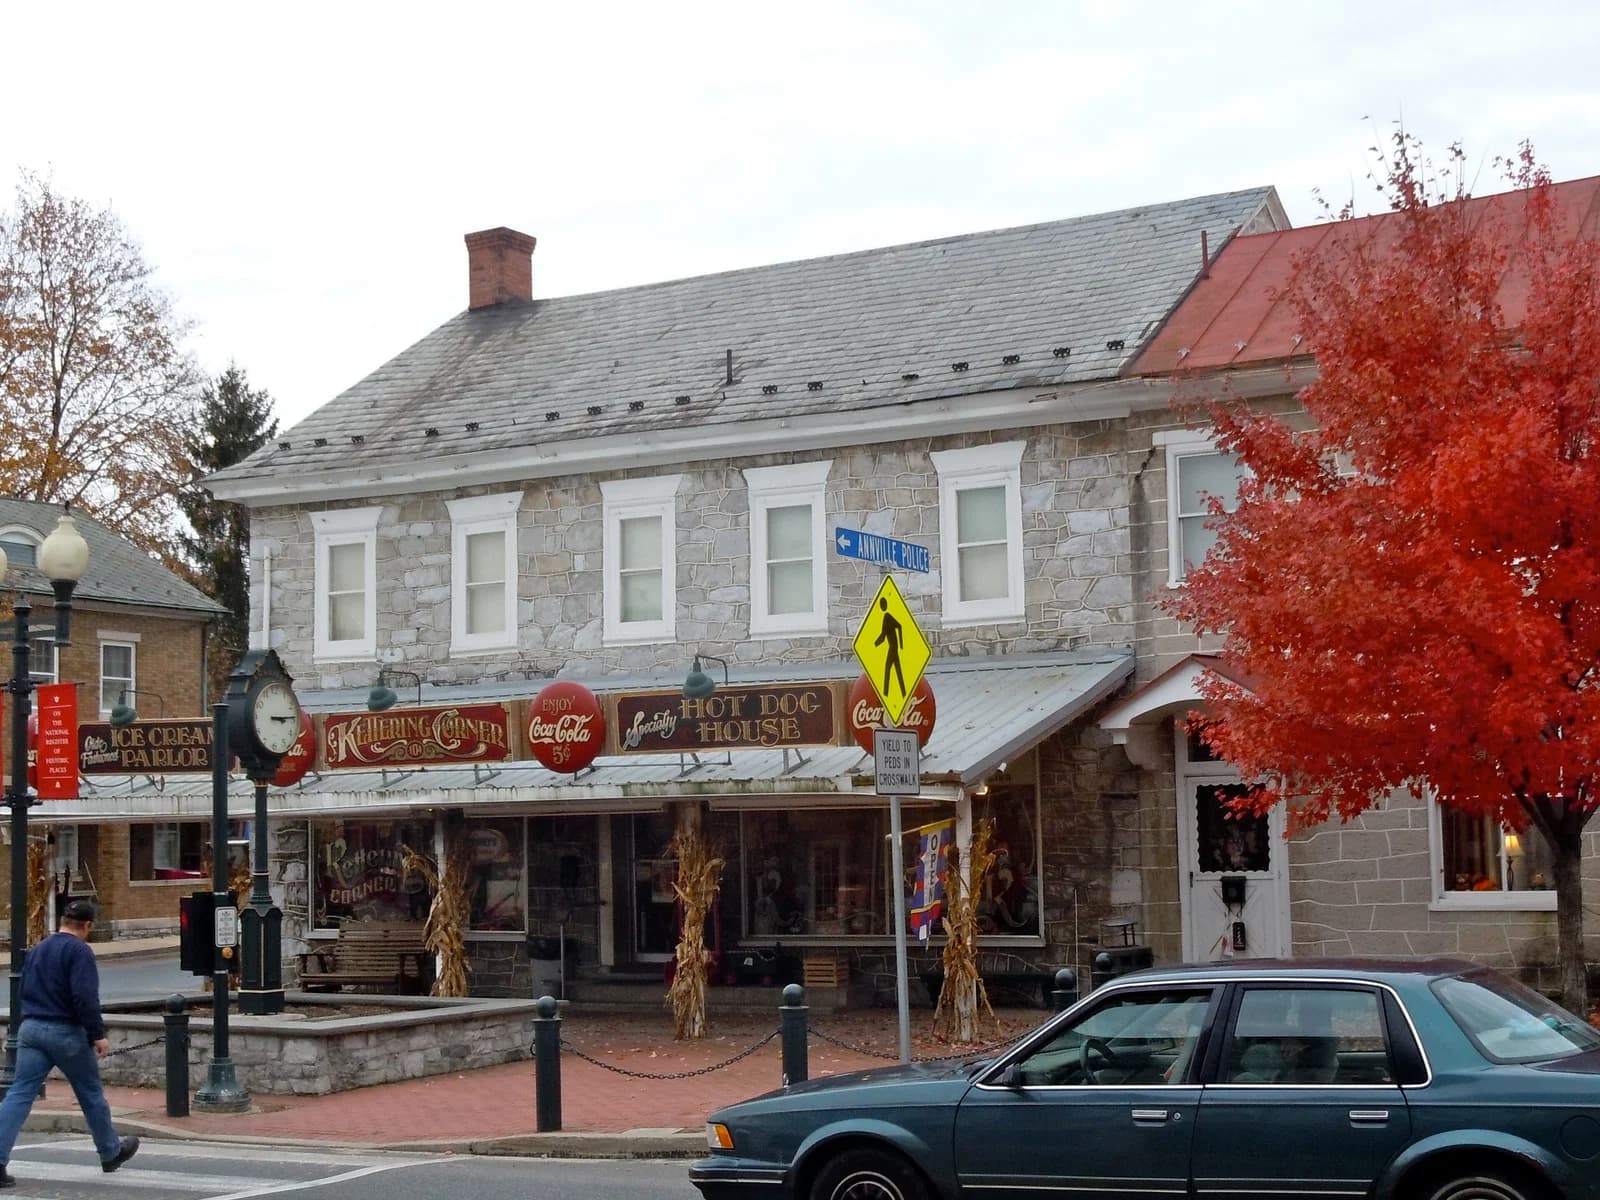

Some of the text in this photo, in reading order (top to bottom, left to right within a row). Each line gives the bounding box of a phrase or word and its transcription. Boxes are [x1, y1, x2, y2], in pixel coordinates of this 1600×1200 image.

[858, 535, 928, 571] ANNVILLE POLICE
[542, 696, 576, 716] ENJOY
[679, 692, 821, 719] HOT DOG
[110, 727, 146, 747] ICE
[529, 714, 594, 744] Coca-Cola
[622, 709, 677, 749] Specialty
[696, 717, 800, 747] HOUSE
[84, 735, 108, 753] Olde
[882, 739, 911, 753] YIELD TO
[121, 748, 209, 767] PARLOR
[884, 757, 910, 769] PEDS IN
[879, 773, 917, 786] CROSSWALK
[929, 834, 938, 904] OPEN
